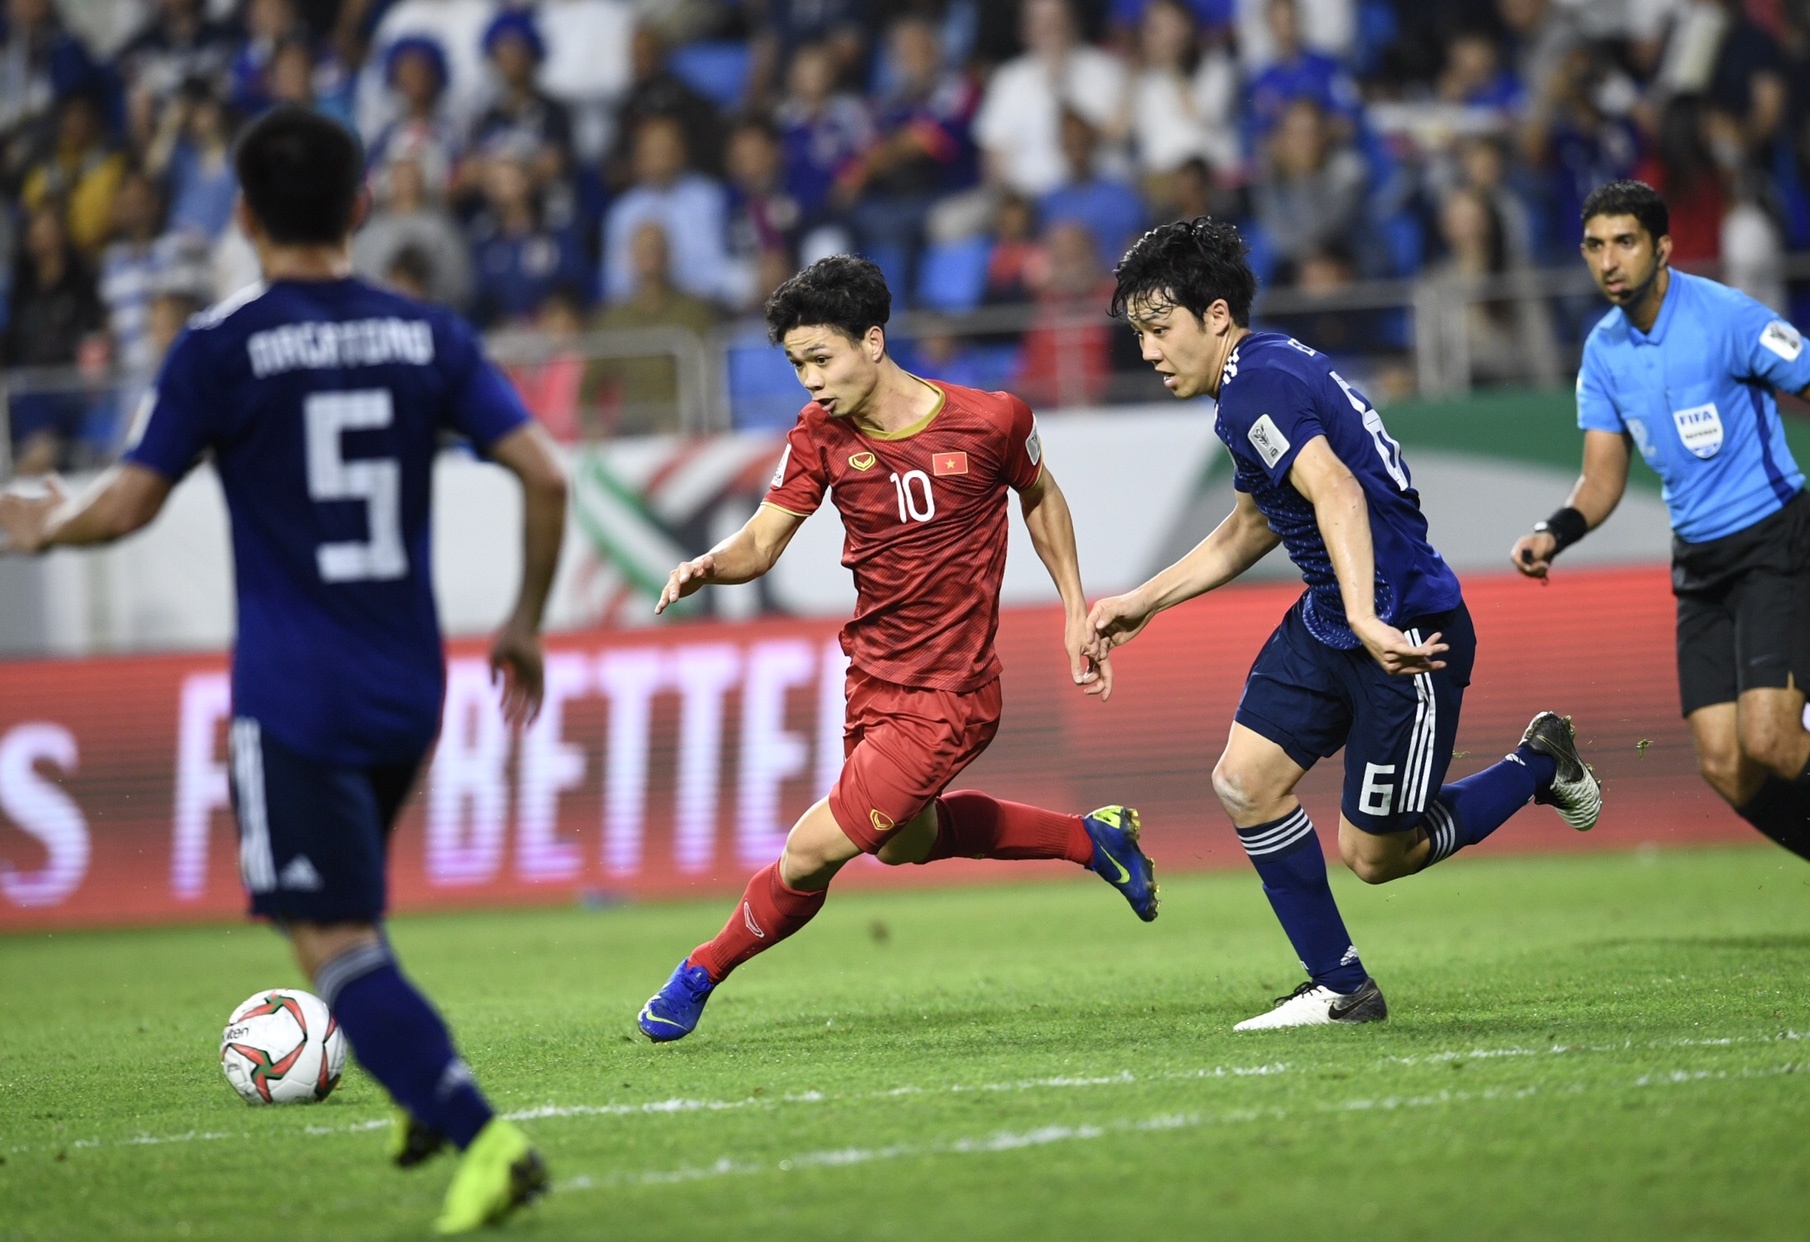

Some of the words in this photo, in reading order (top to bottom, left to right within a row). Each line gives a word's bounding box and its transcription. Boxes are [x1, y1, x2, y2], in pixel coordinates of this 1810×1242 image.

[1679, 411, 1712, 426] FIFA
[302, 387, 411, 584] 5
[889, 469, 936, 524] 10
[424, 637, 850, 886] BETTE
[1359, 762, 1395, 816] 6
